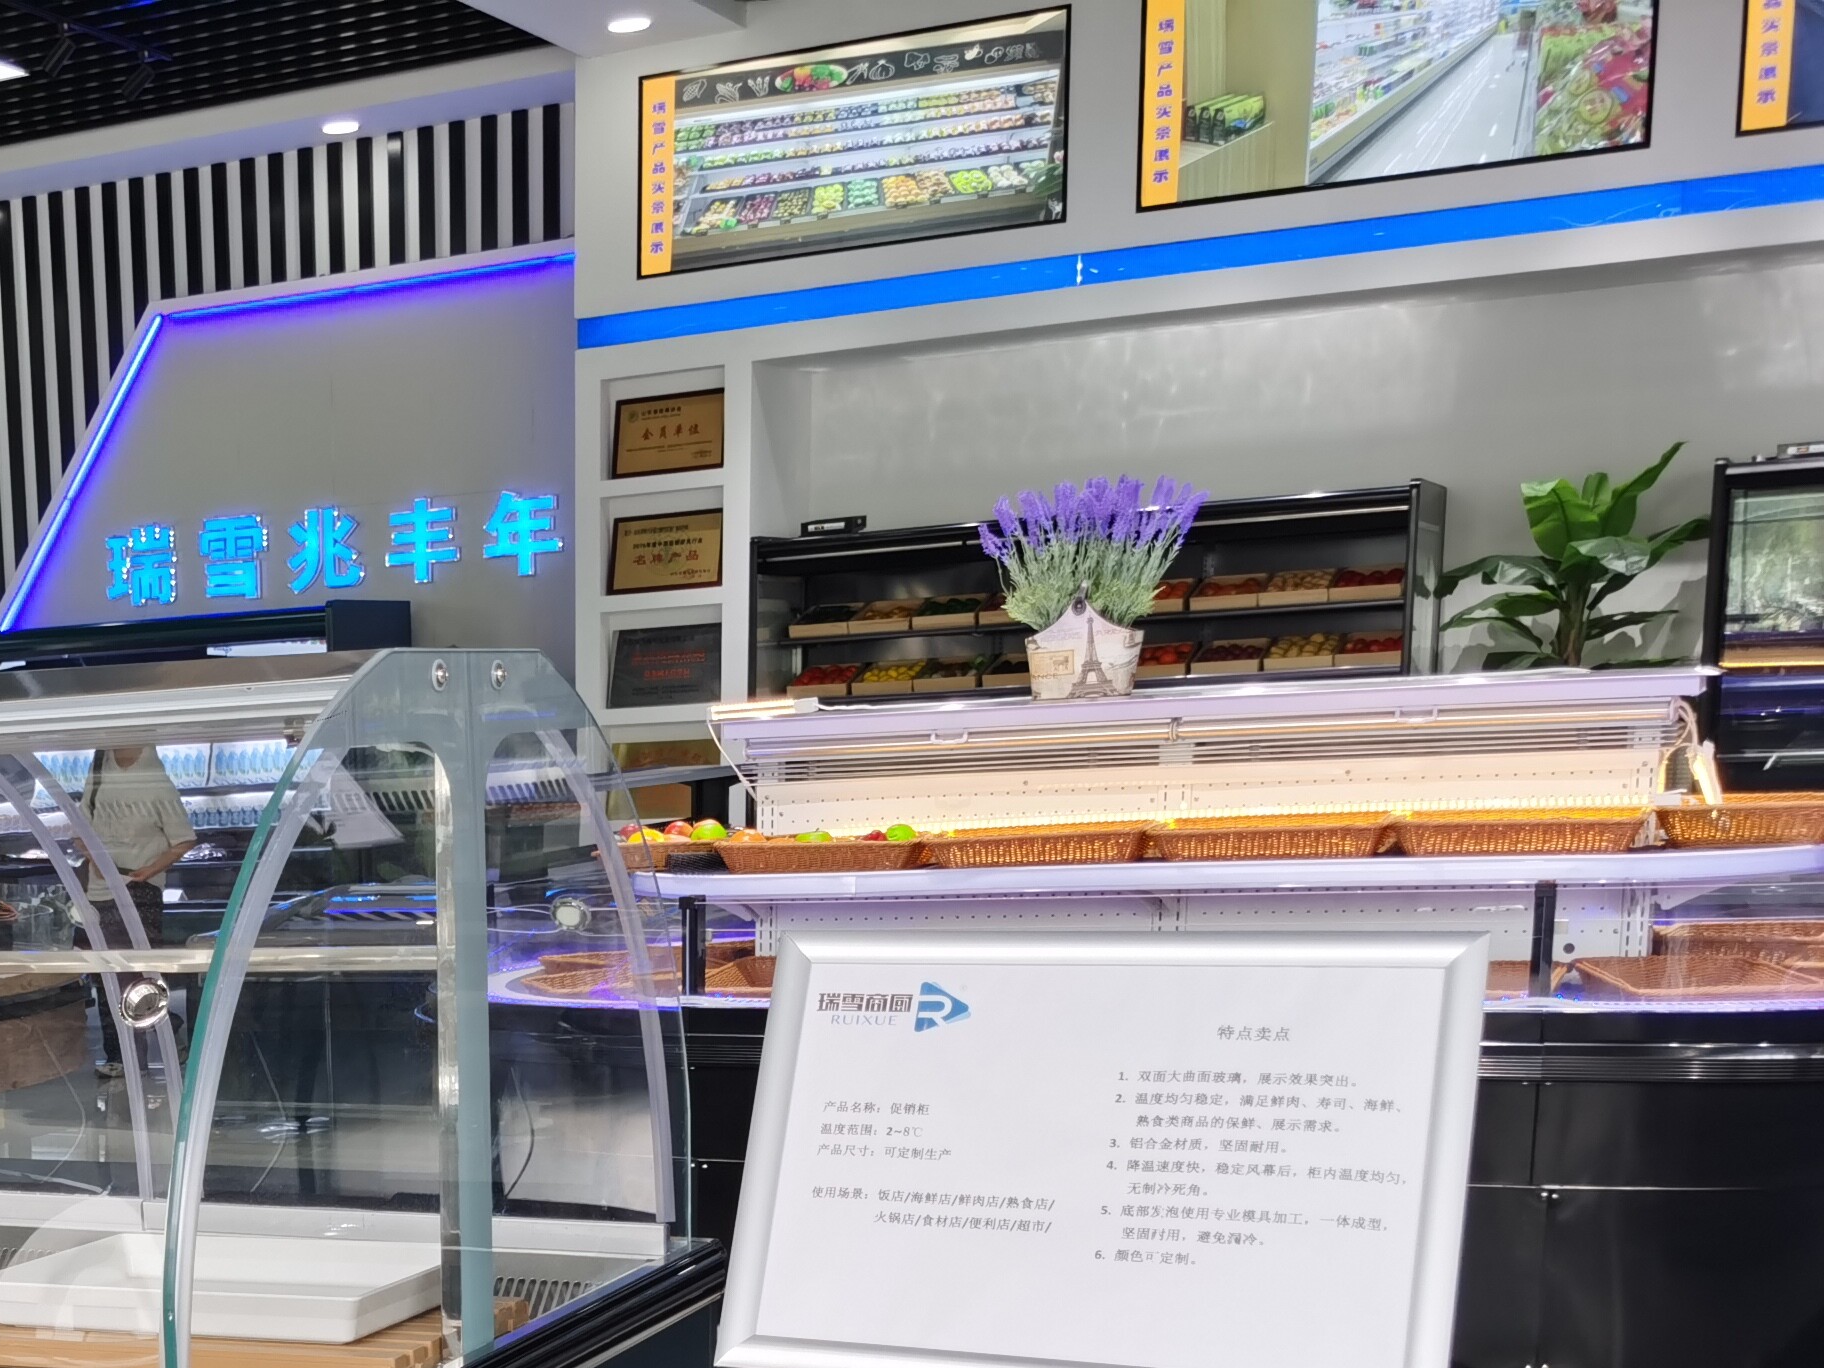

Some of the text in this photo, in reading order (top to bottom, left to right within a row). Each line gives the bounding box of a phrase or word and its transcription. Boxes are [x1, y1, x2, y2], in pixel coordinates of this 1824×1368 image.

[105, 490, 564, 607] 瑞雪兆丰年
[830, 1014, 899, 1026] RUIXUE
[1217, 1025, 1291, 1042] 特点卖点
